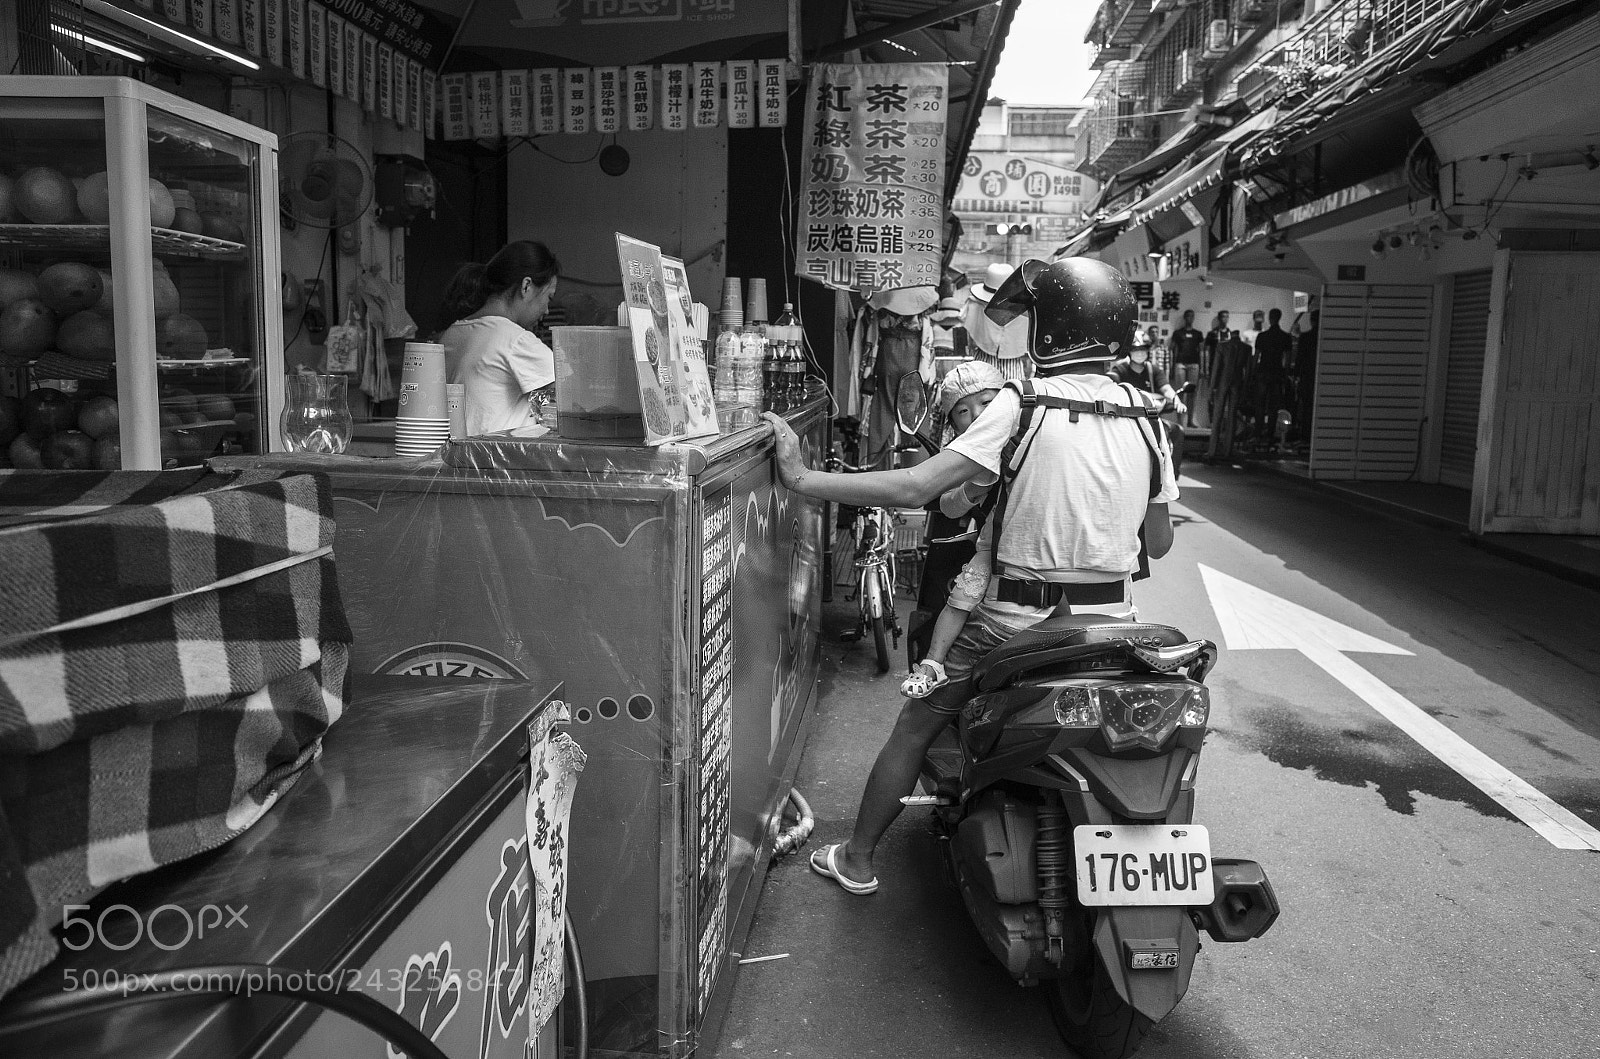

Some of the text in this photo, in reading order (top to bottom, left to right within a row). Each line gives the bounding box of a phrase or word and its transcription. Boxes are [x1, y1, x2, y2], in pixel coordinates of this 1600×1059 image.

[707, 13, 736, 22] SHOP
[478, 77, 492, 120] 楊桃汁
[509, 75, 523, 118] 高山青茶
[540, 74, 554, 117] 冬瓜檸檬
[571, 73, 584, 116] 綠豆沙
[601, 71, 615, 116] 綠豆沙牛奶
[634, 70, 648, 113] 冬瓜鮮奶
[668, 69, 682, 113] 檸檬汁
[700, 67, 714, 110] 木瓜牛奶
[734, 65, 748, 110] 西瓜汁
[766, 64, 780, 109] 西瓜牛奶
[816, 83, 908, 113] 紅茶
[813, 118, 907, 149] 綠茶
[810, 153, 906, 184] 奶茶
[808, 187, 905, 219] 珍珠奶茶
[807, 223, 904, 254] 炭焙烏龍
